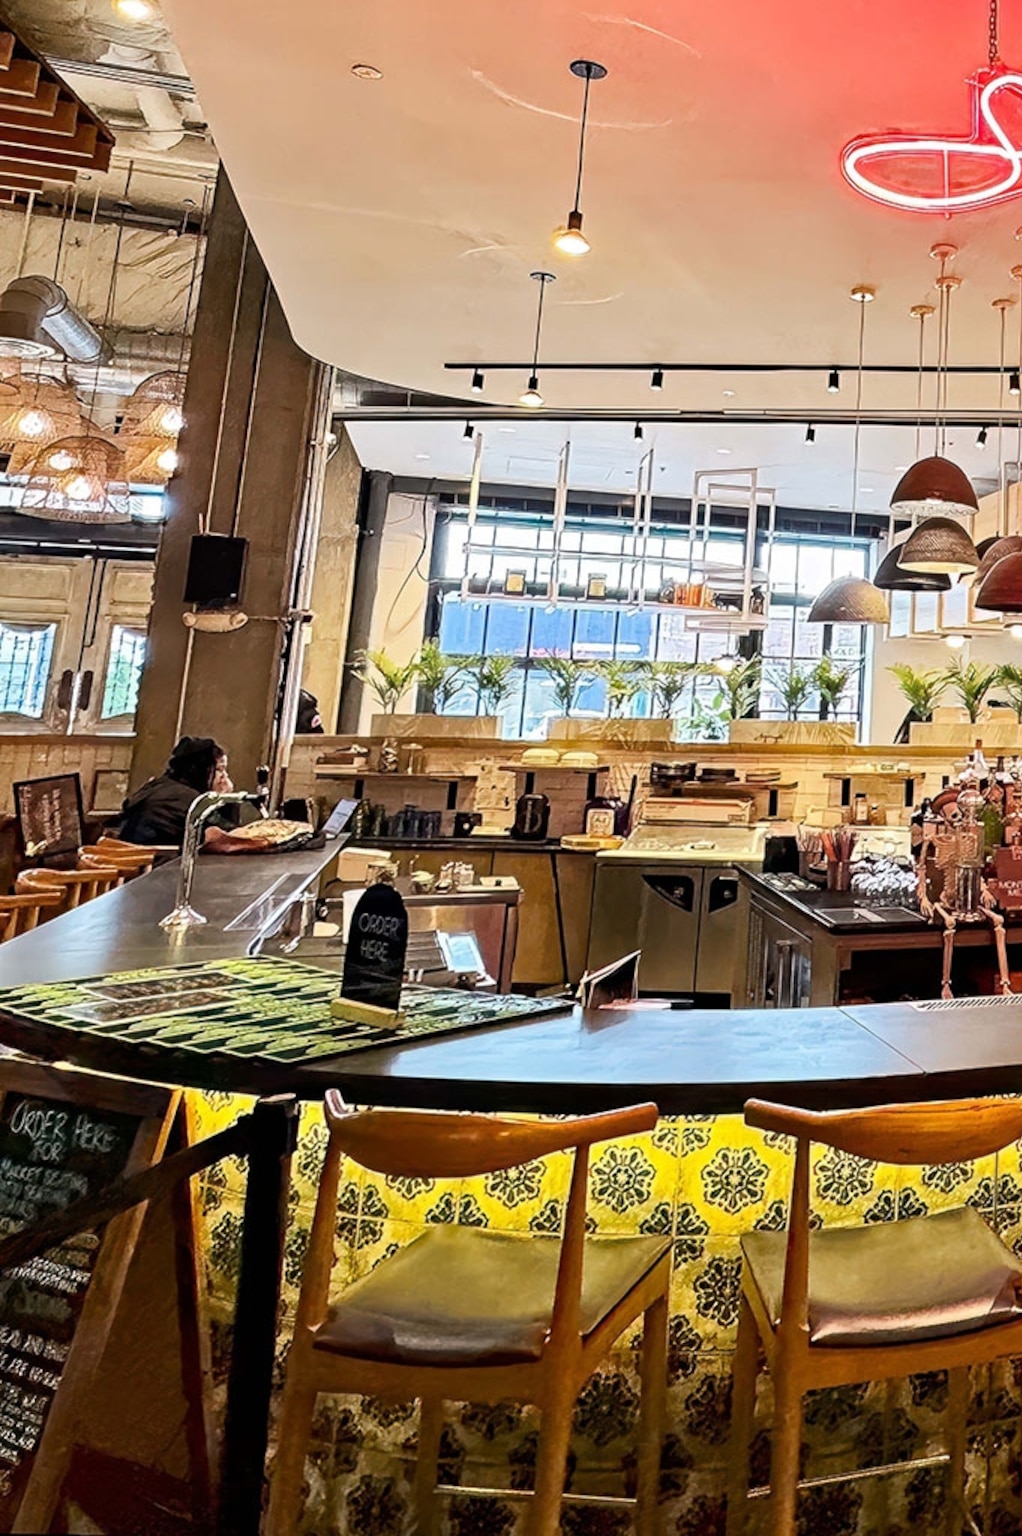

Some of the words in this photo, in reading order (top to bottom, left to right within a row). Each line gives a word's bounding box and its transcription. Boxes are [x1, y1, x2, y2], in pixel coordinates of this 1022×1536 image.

[358, 911, 400, 937] ORDER
[360, 938, 390, 963] HERE
[9, 1099, 69, 1142] ORDER
[73, 1113, 119, 1154] HERE
[30, 1140, 63, 1164] FOR
